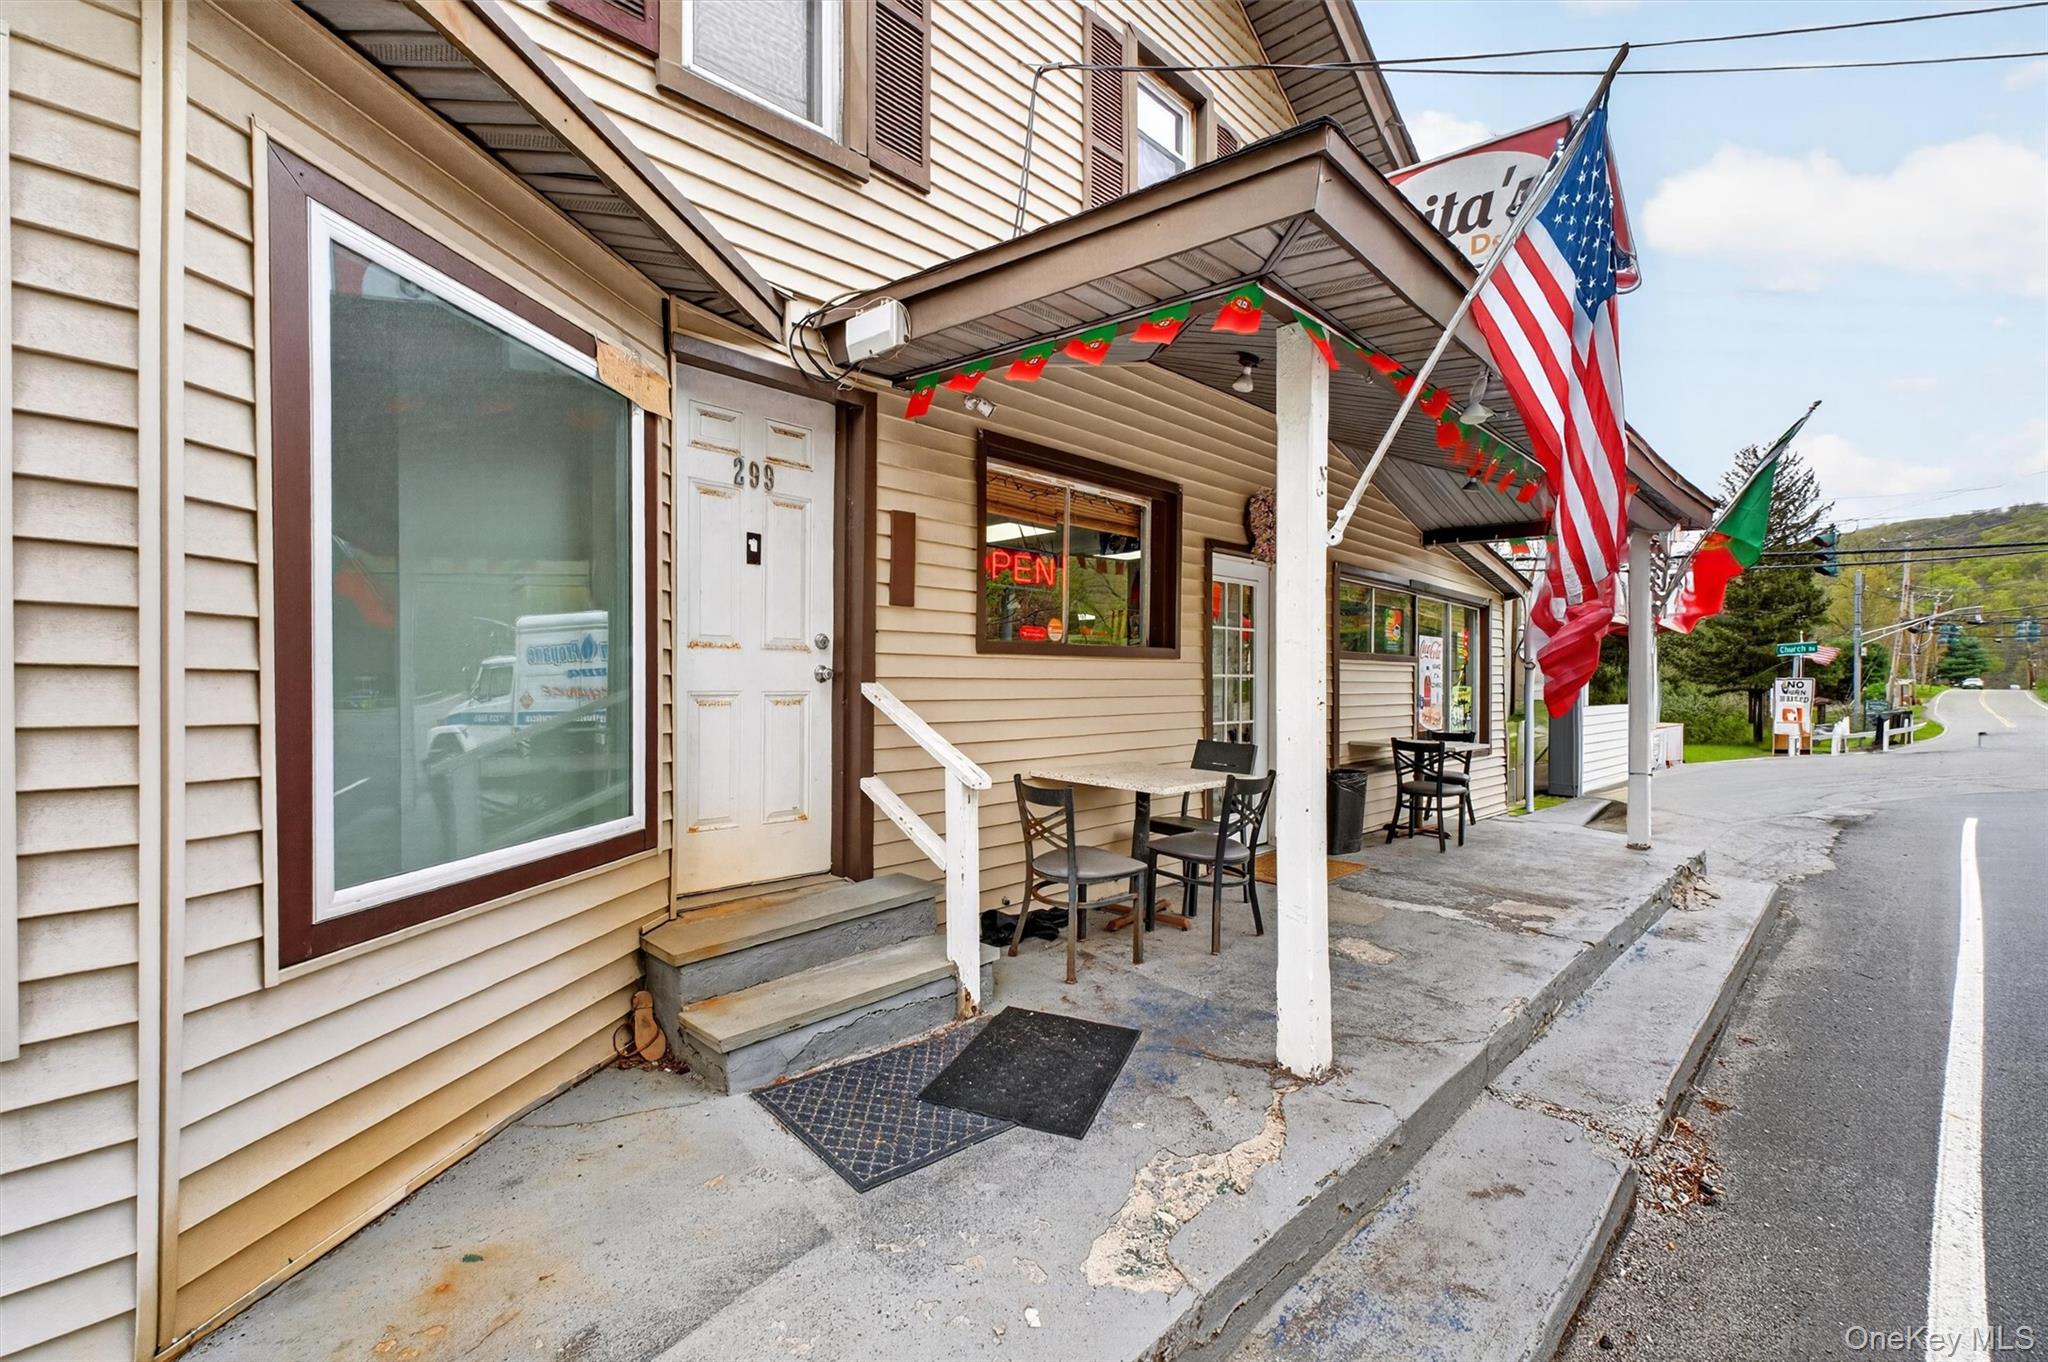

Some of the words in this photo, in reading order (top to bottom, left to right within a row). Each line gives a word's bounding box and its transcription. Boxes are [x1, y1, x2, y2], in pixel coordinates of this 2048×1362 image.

[733, 456, 774, 491] 299
[986, 551, 1055, 586] PEN
[1780, 645, 1806, 654] Church
[1787, 681, 1804, 689] NO
